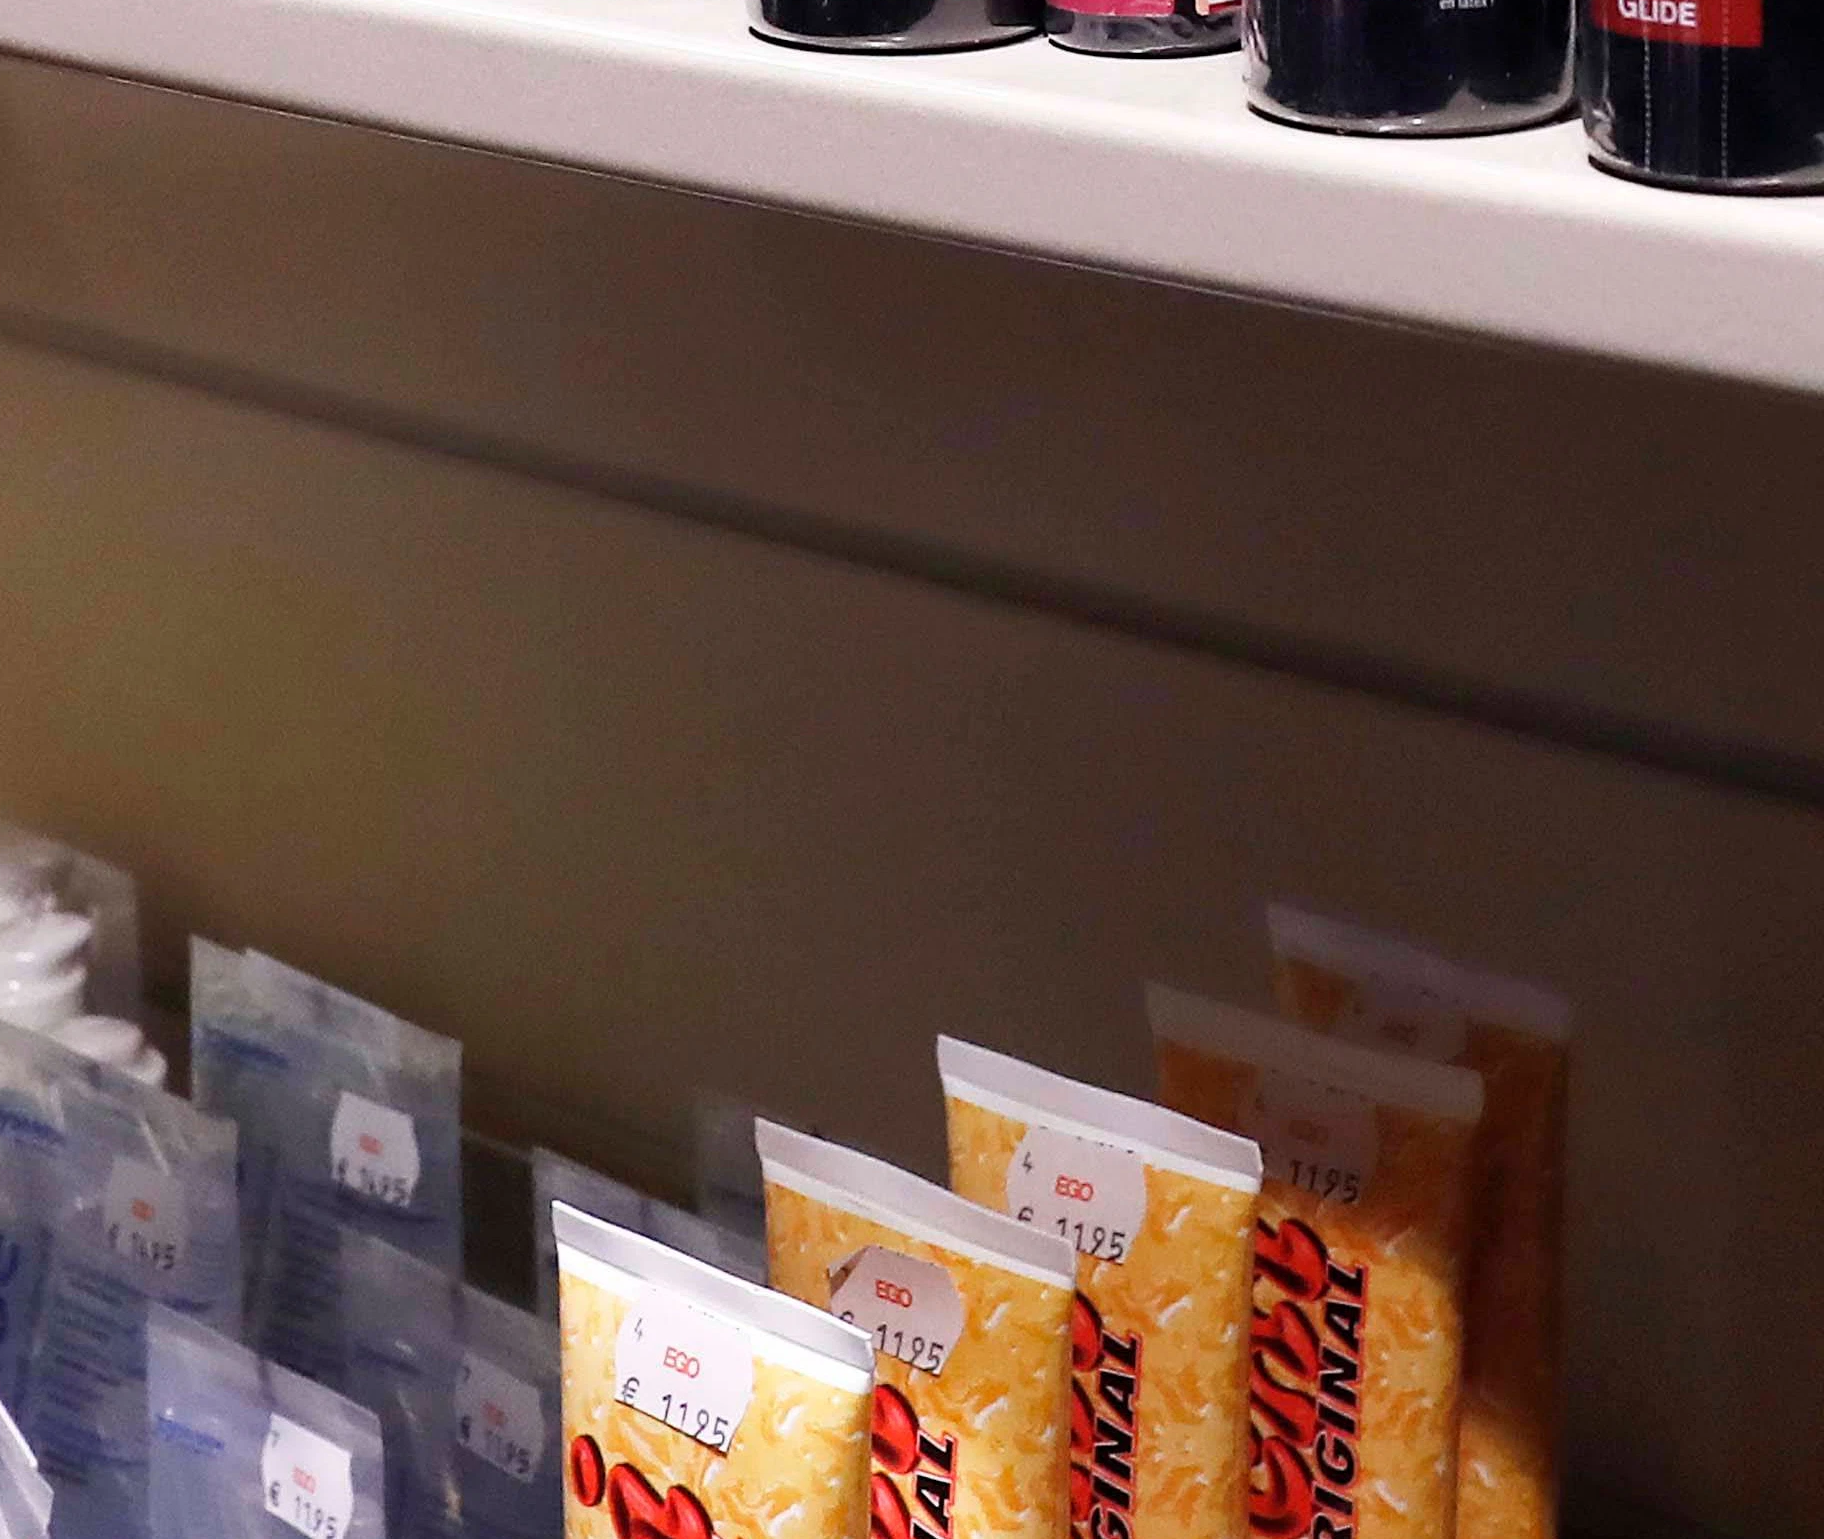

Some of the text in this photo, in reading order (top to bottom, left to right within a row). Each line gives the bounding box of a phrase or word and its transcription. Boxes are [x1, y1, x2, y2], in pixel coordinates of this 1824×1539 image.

[1055, 1175, 1094, 1202] EGO
[875, 1279, 913, 1308] EGO
[663, 1346, 701, 1379] EGO
[1309, 1260, 1369, 1539] RIGINAL
